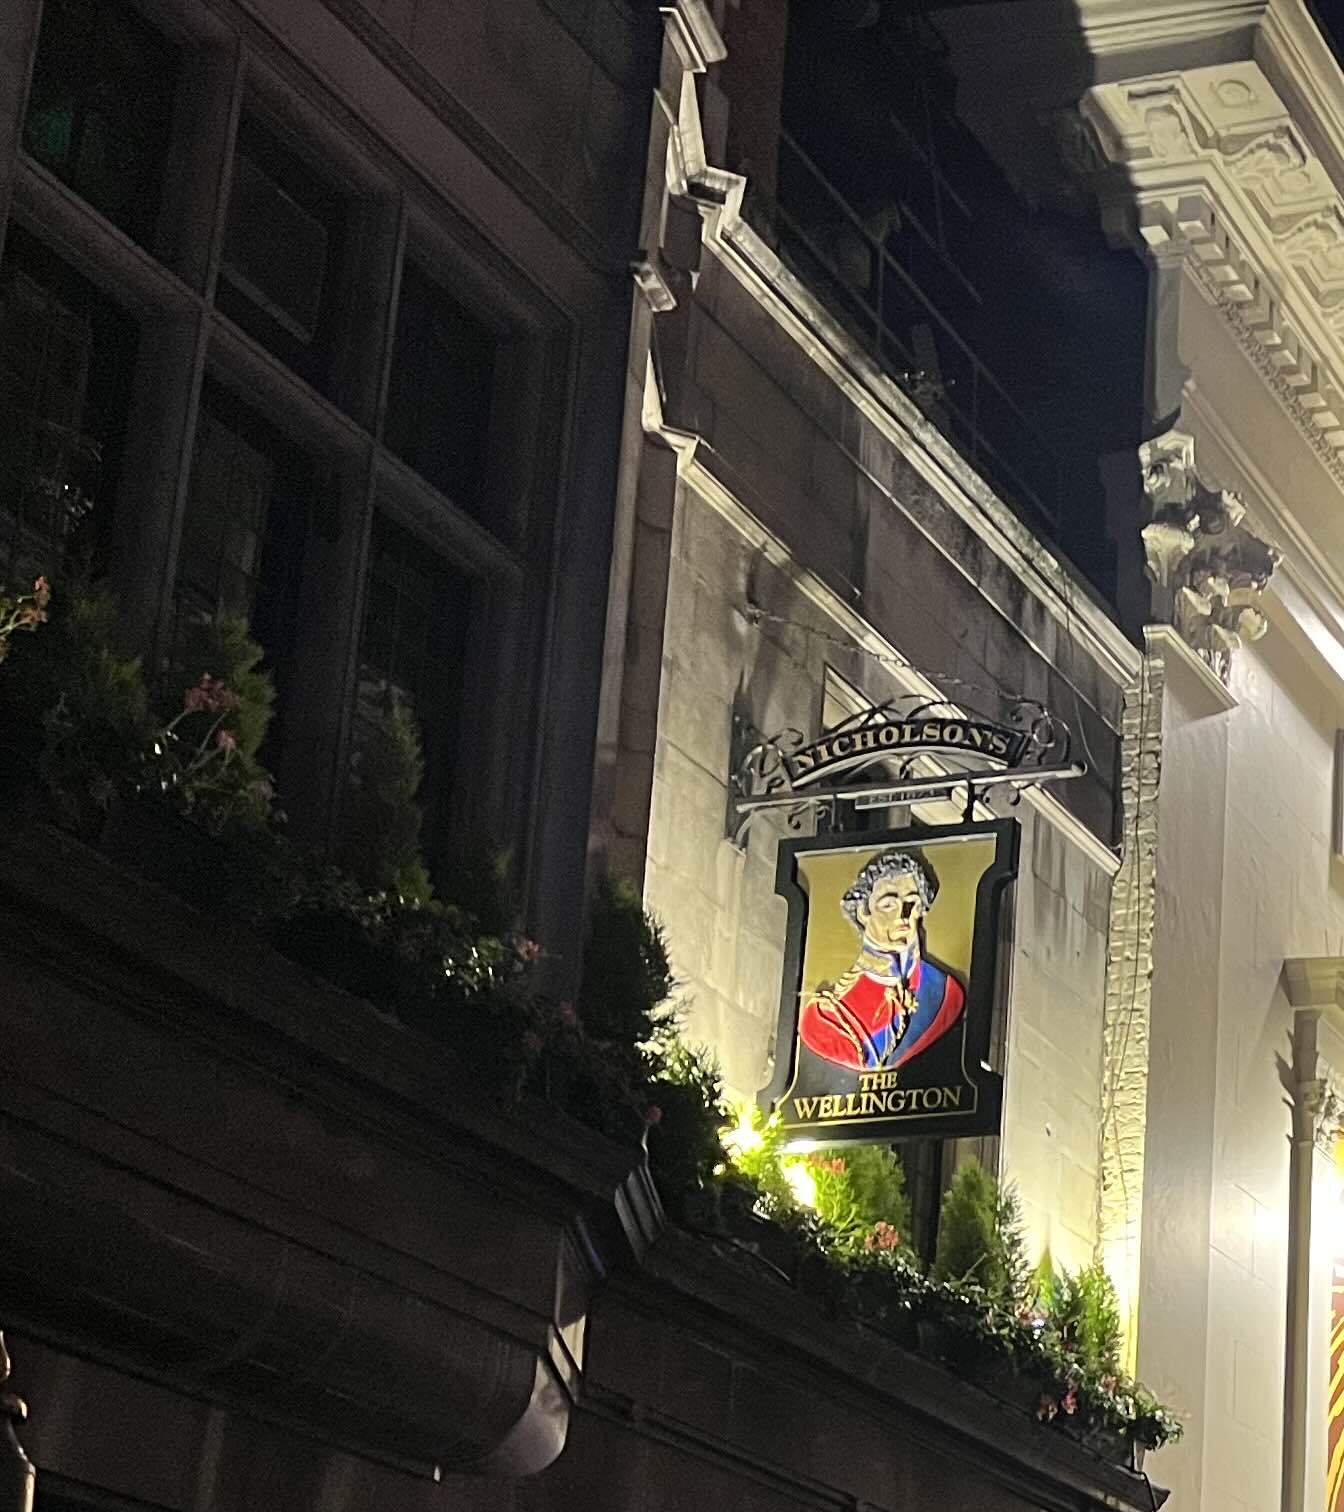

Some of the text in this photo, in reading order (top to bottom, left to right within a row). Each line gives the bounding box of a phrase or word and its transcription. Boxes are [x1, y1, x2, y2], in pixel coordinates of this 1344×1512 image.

[794, 724, 1012, 771] NICHOLSON'S
[859, 1071, 898, 1091] THE
[793, 1086, 962, 1119] WELLINGTON
